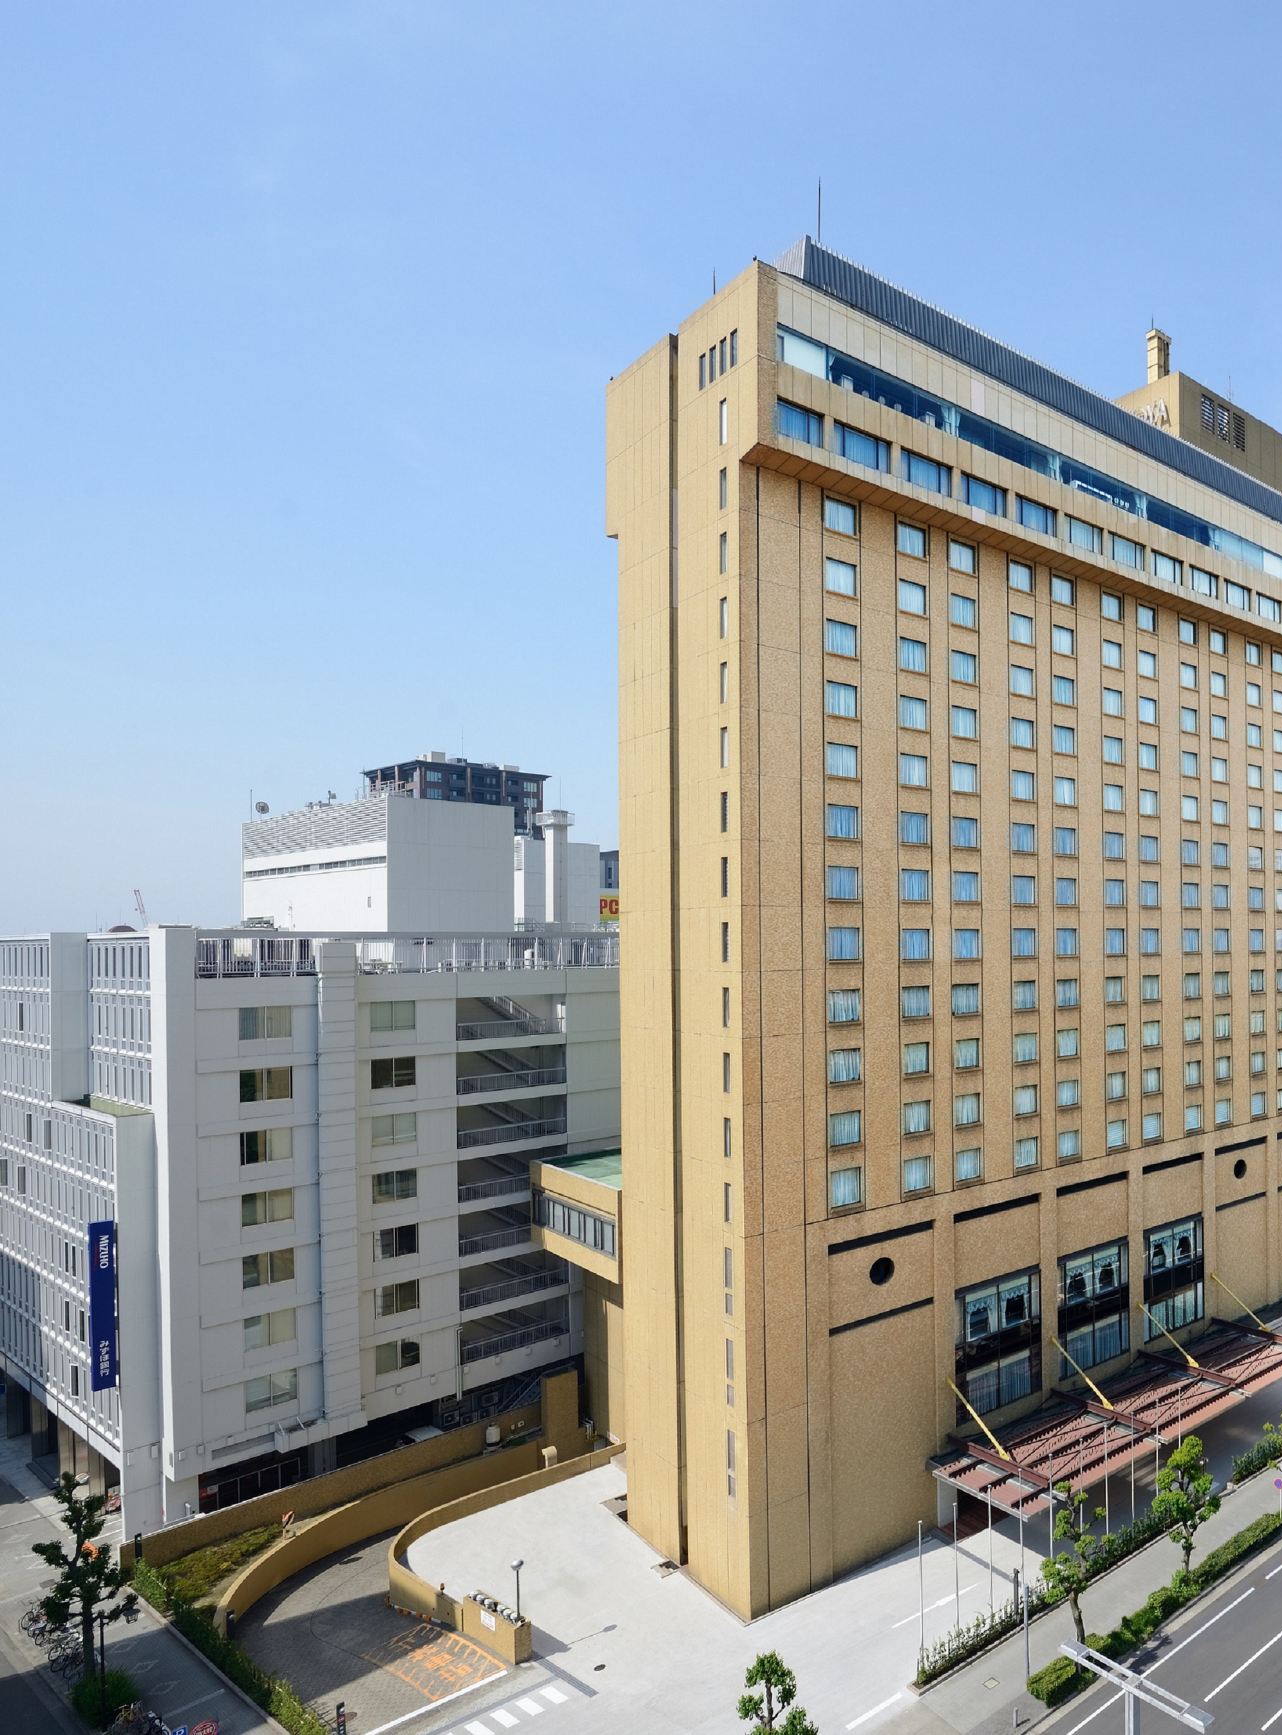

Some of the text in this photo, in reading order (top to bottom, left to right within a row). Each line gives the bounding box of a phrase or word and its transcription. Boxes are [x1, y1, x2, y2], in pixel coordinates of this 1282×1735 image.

[99, 1234, 109, 1269] MIZUHO
[99, 1340, 110, 1377] みずほ銀行
